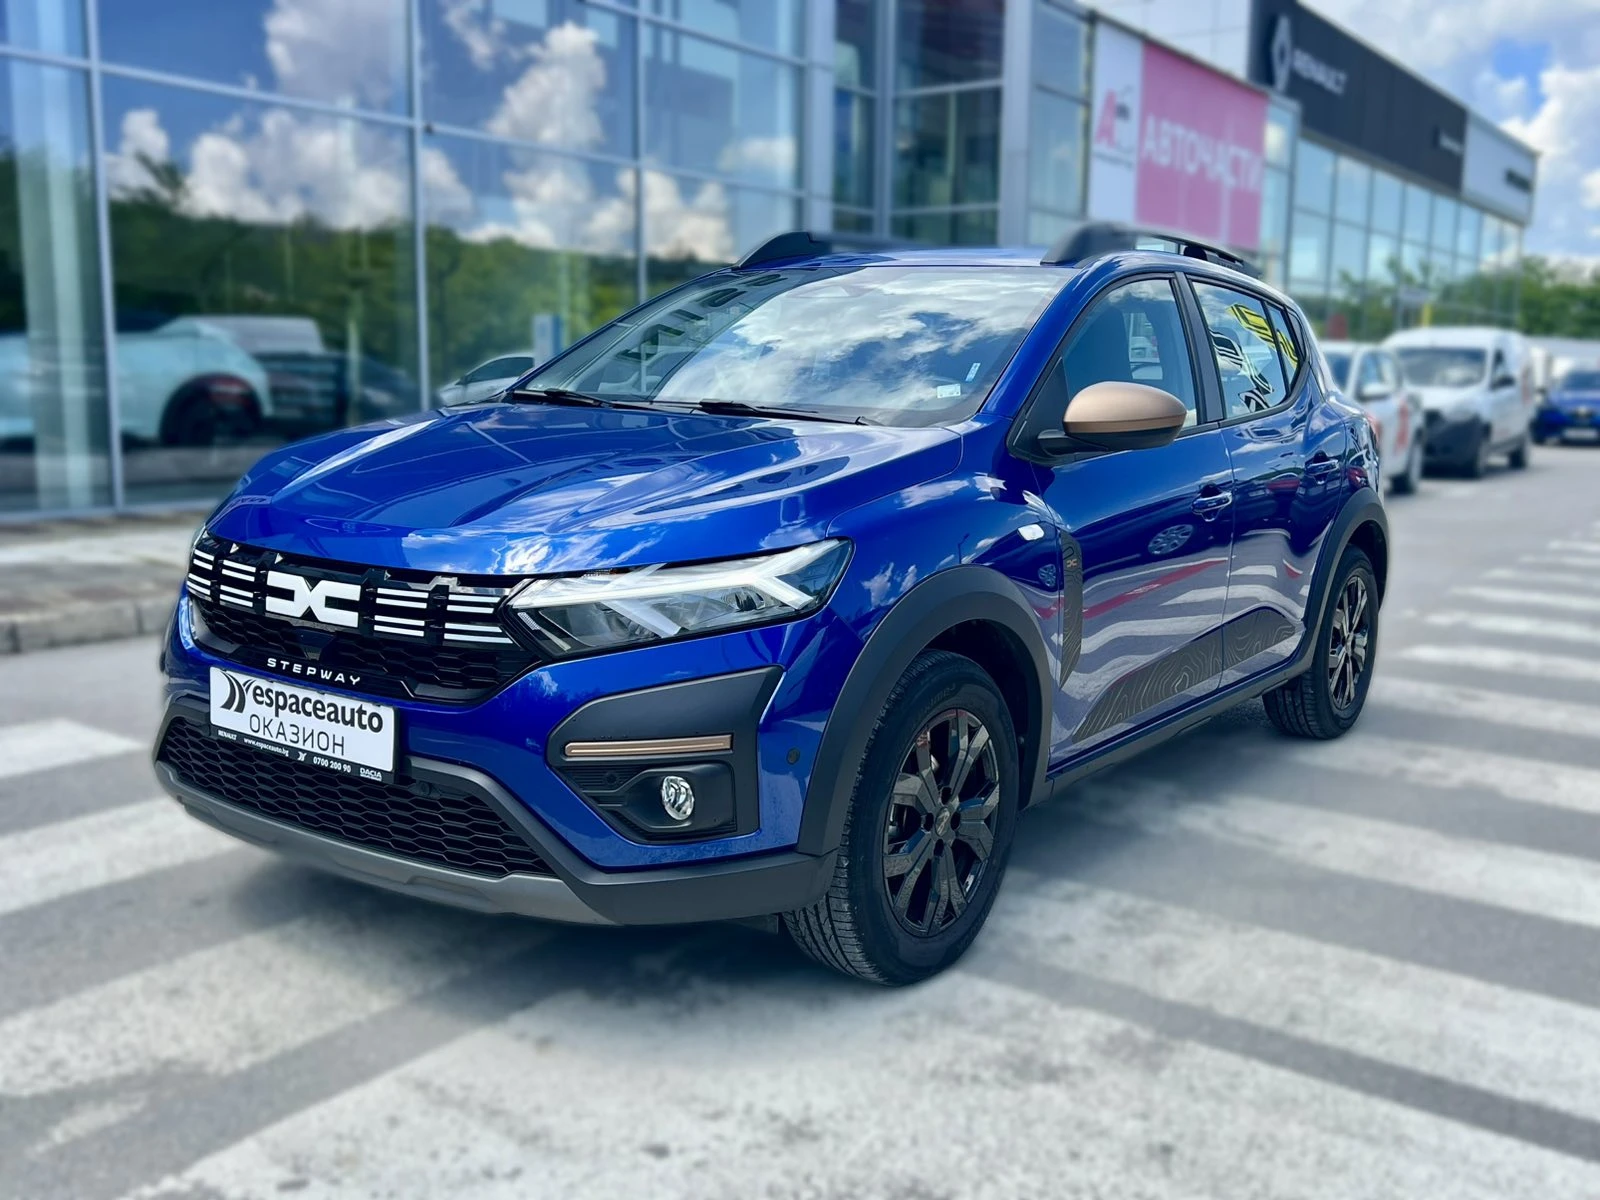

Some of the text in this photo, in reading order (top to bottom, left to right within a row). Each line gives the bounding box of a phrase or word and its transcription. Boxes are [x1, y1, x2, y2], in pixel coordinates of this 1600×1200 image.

[1143, 115, 1263, 191] АВТОЧАСТИ
[267, 657, 360, 685] STEPWAY
[252, 684, 383, 733] espaceauto
[249, 713, 345, 756] ОКАЗИОН
[313, 756, 352, 773] 0700 200 90
[359, 767, 382, 778] DACIA
